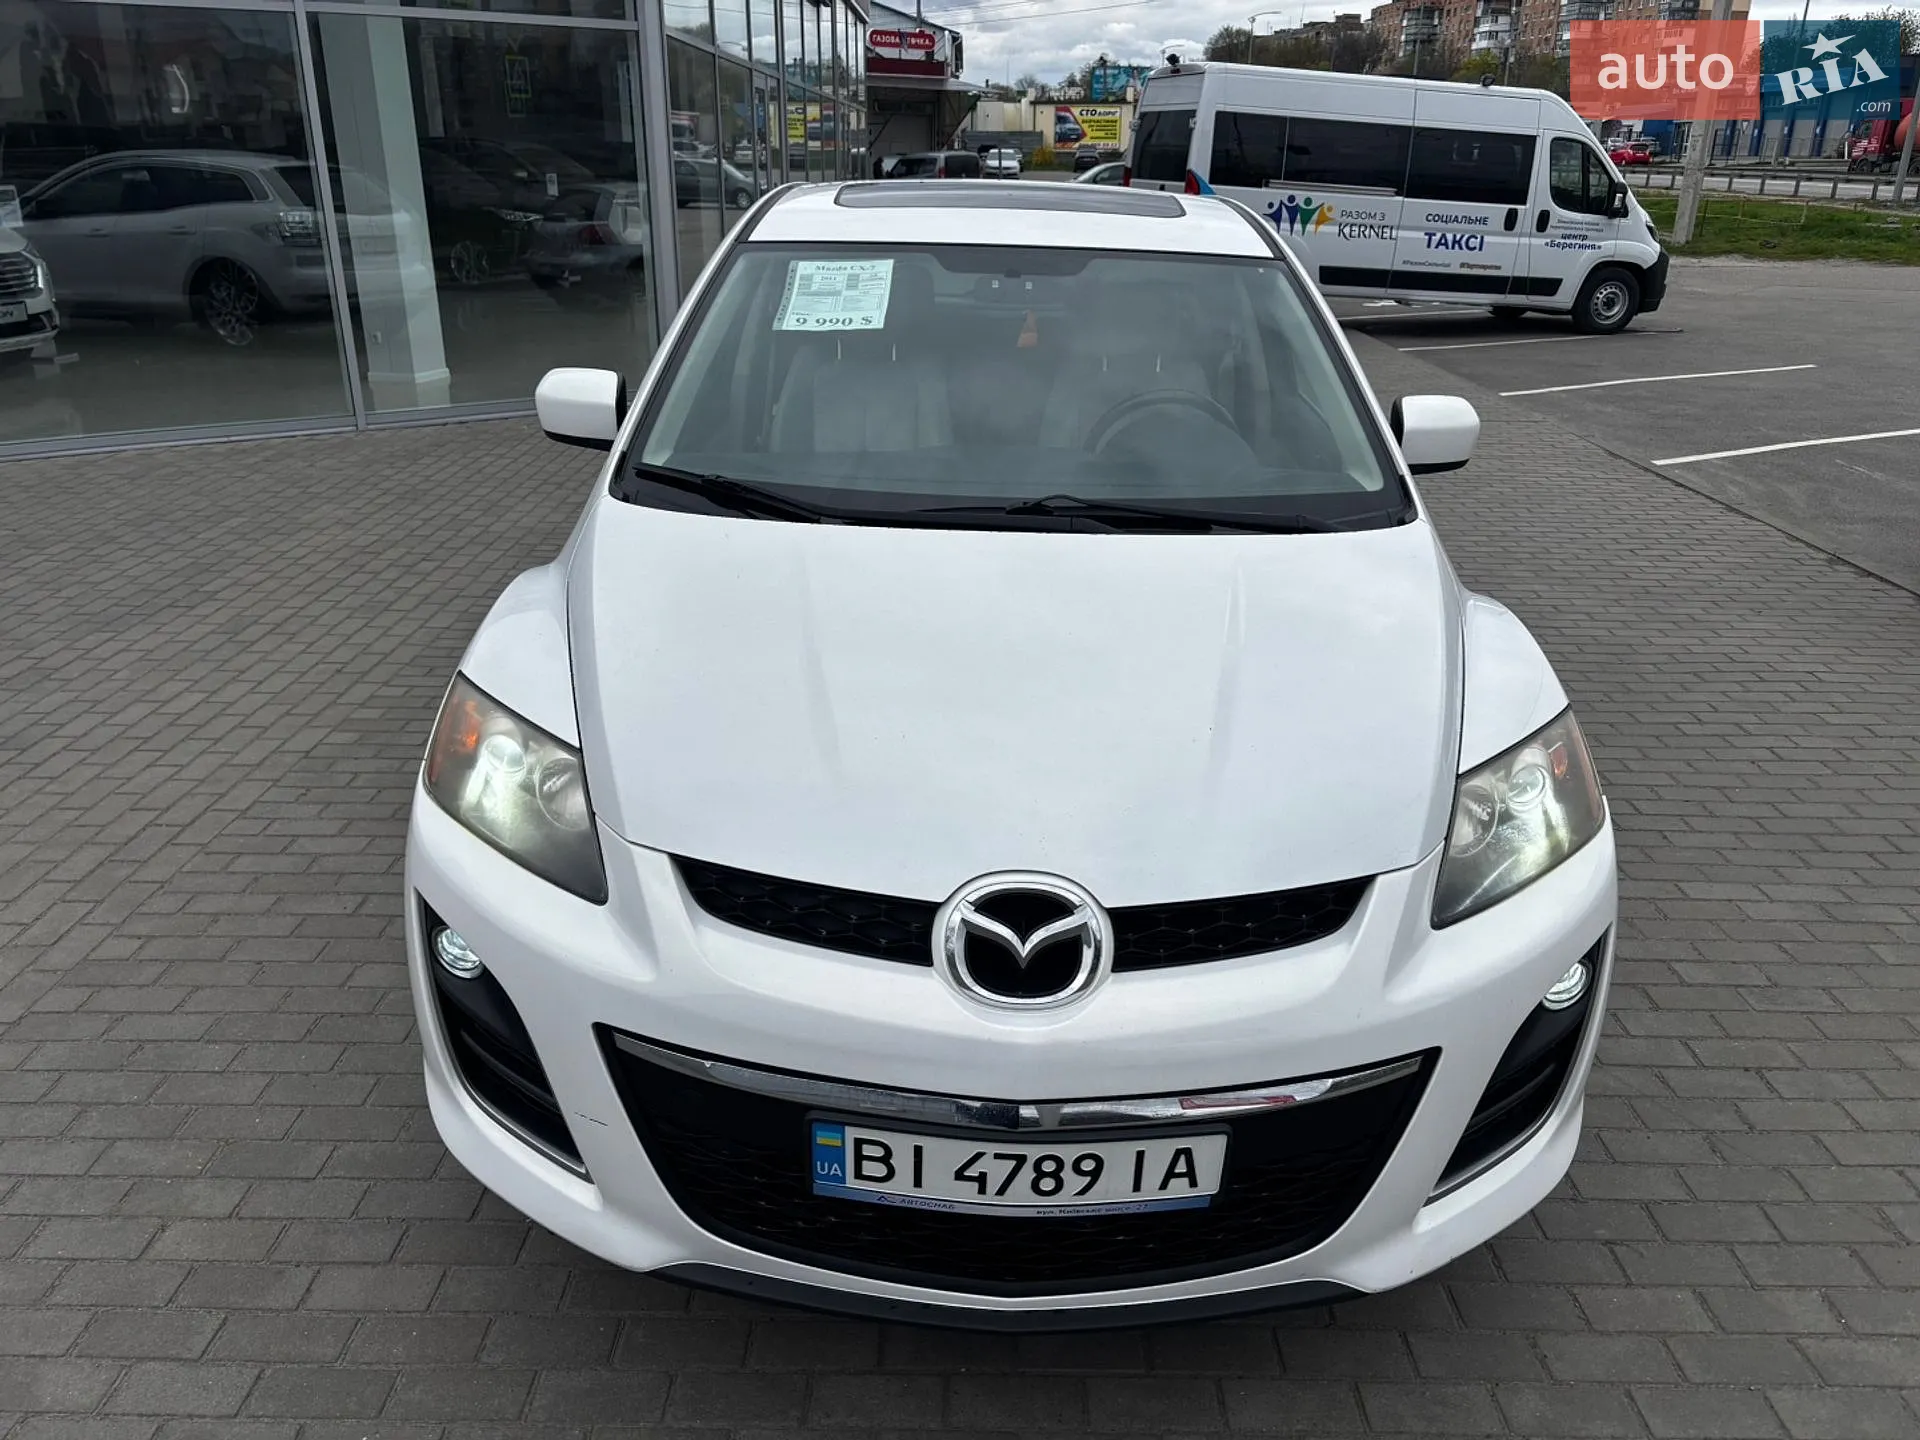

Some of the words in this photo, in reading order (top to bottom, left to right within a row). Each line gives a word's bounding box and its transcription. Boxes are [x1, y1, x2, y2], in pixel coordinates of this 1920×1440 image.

[872, 34, 900, 43] ГАЗОВА
[1079, 109, 1097, 117] СТО
[1340, 210, 1377, 221] РАЗОМ
[1425, 213, 1490, 226] СОЦІАЛЬНЕ
[1337, 222, 1397, 241] KERNEL
[1561, 233, 1588, 241] центр
[1424, 231, 1485, 252] ТАКСІ
[815, 317, 853, 327] 990
[860, 315, 873, 326] $
[816, 1160, 842, 1177] UA
[852, 1136, 924, 1189] BI
[953, 1150, 1105, 1197] 4789
[1131, 1146, 1199, 1193] IA
